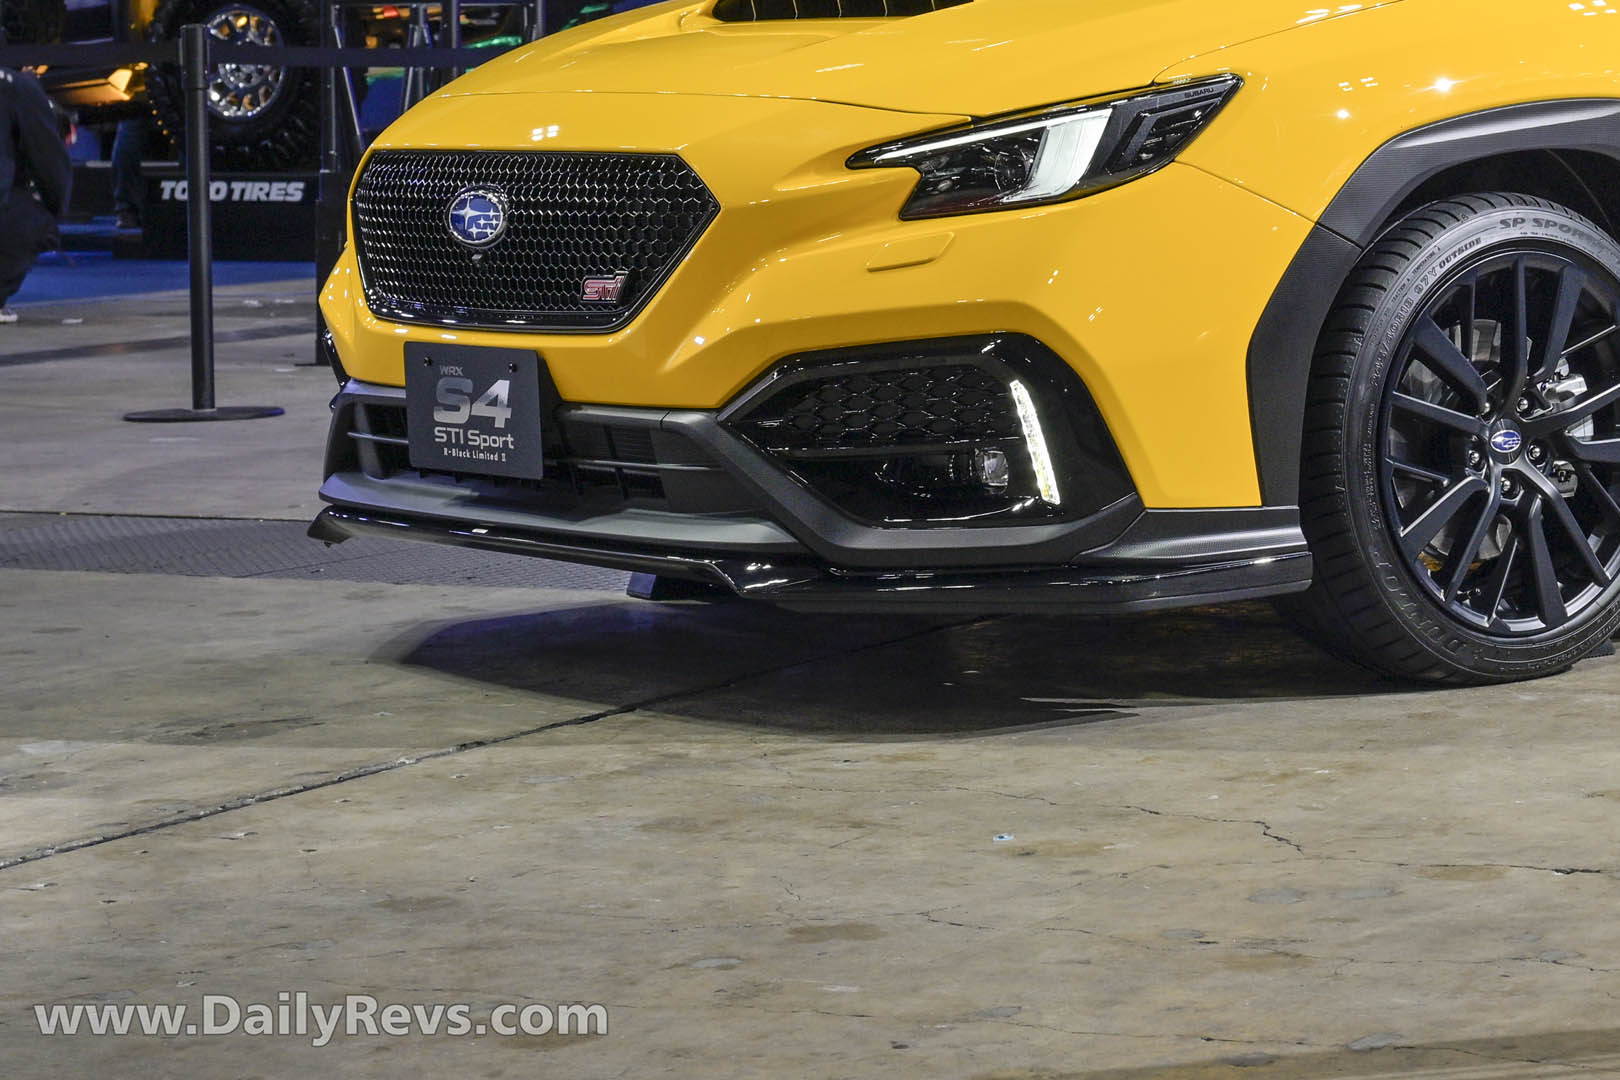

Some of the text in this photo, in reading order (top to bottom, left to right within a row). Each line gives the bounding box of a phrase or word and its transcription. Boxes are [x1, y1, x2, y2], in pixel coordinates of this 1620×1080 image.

[1184, 87, 1214, 98] SUBARU
[160, 180, 305, 202] TOO TIRES
[1499, 217, 1526, 229] SP
[1438, 236, 1482, 269] OUTSIDE
[440, 365, 464, 376] WRX
[433, 376, 512, 428] S4
[434, 427, 514, 449] STI Sport
[443, 447, 471, 459] R-Black
[472, 450, 499, 462] Limited
